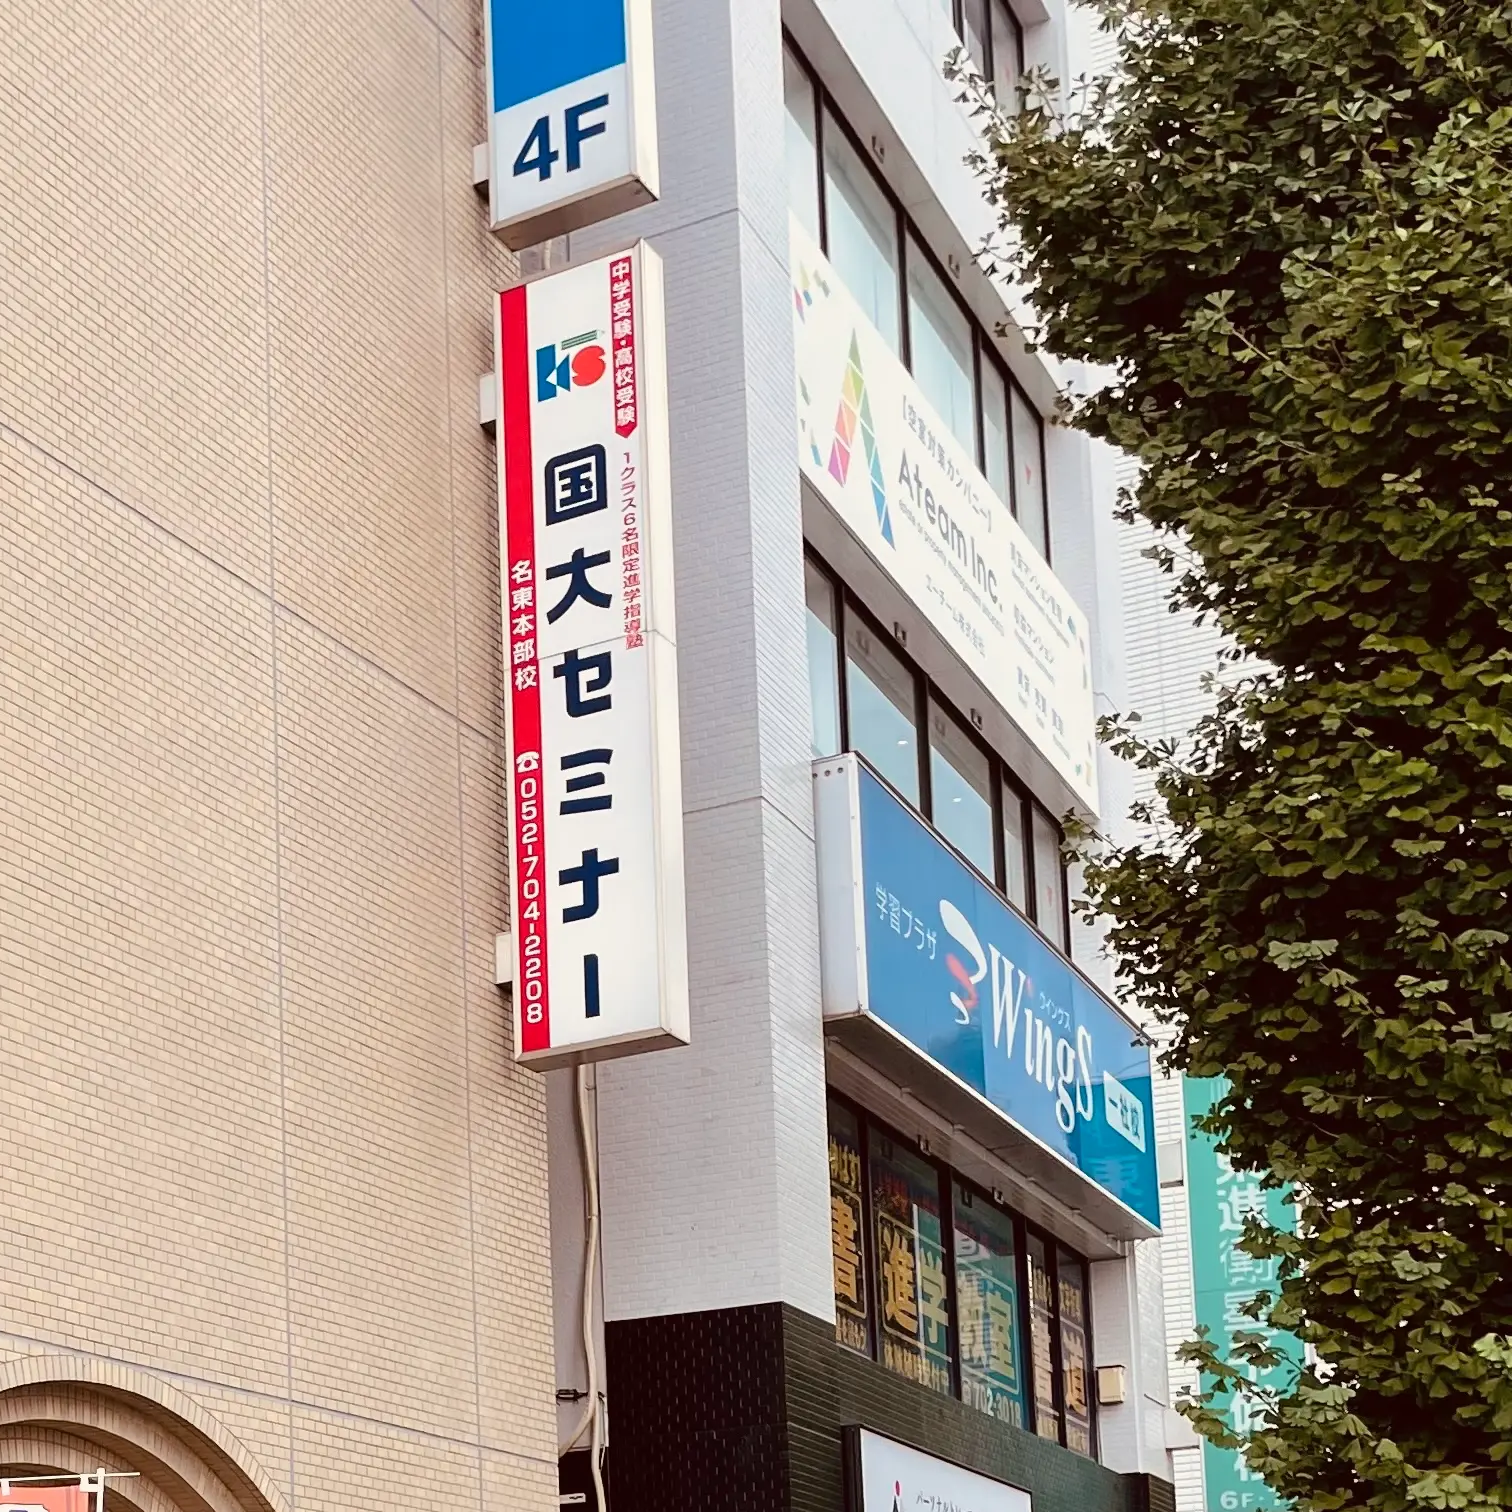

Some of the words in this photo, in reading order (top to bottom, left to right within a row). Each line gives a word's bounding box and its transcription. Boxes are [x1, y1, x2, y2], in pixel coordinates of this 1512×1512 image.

[513, 93, 609, 182] 4F
[898, 448, 968, 568] Ateam
[970, 536, 1004, 612] Inc.
[510, 559, 538, 691] 名東本部校
[544, 443, 619, 1018] 国大セミナー
[520, 777, 542, 1024] 052-704-2208
[875, 882, 937, 960] 学習プラザ
